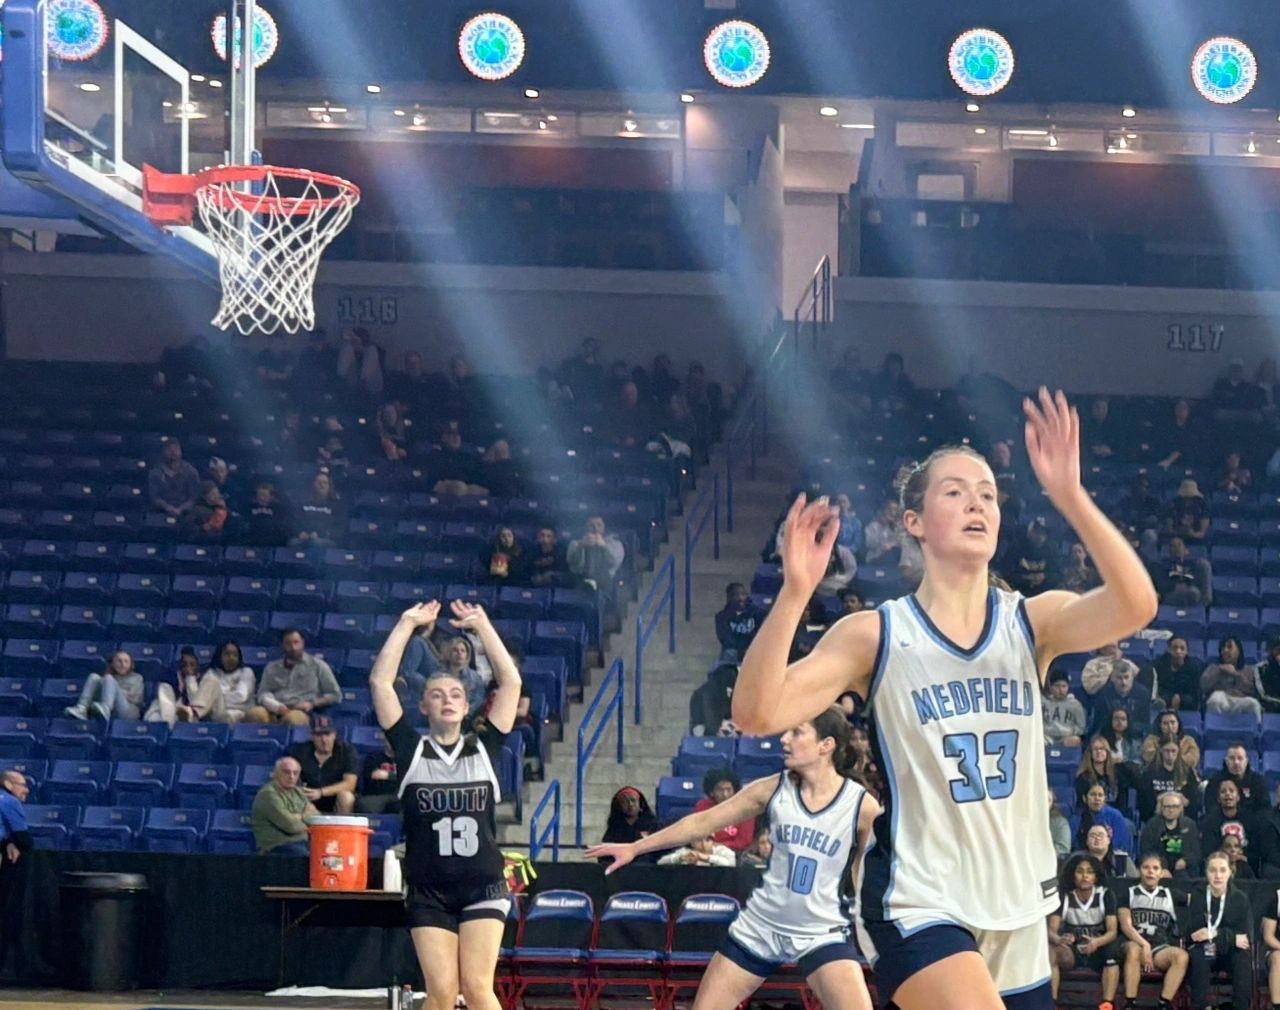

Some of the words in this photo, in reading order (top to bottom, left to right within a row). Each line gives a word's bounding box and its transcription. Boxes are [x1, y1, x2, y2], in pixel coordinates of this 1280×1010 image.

[1167, 323, 1225, 352] 117
[911, 677, 1035, 726] MEDFIELD
[942, 729, 1020, 804] 33
[416, 786, 489, 812] SOUTH
[431, 816, 479, 858] 13
[775, 823, 842, 857] MEDFIELD
[787, 853, 818, 896] 10
